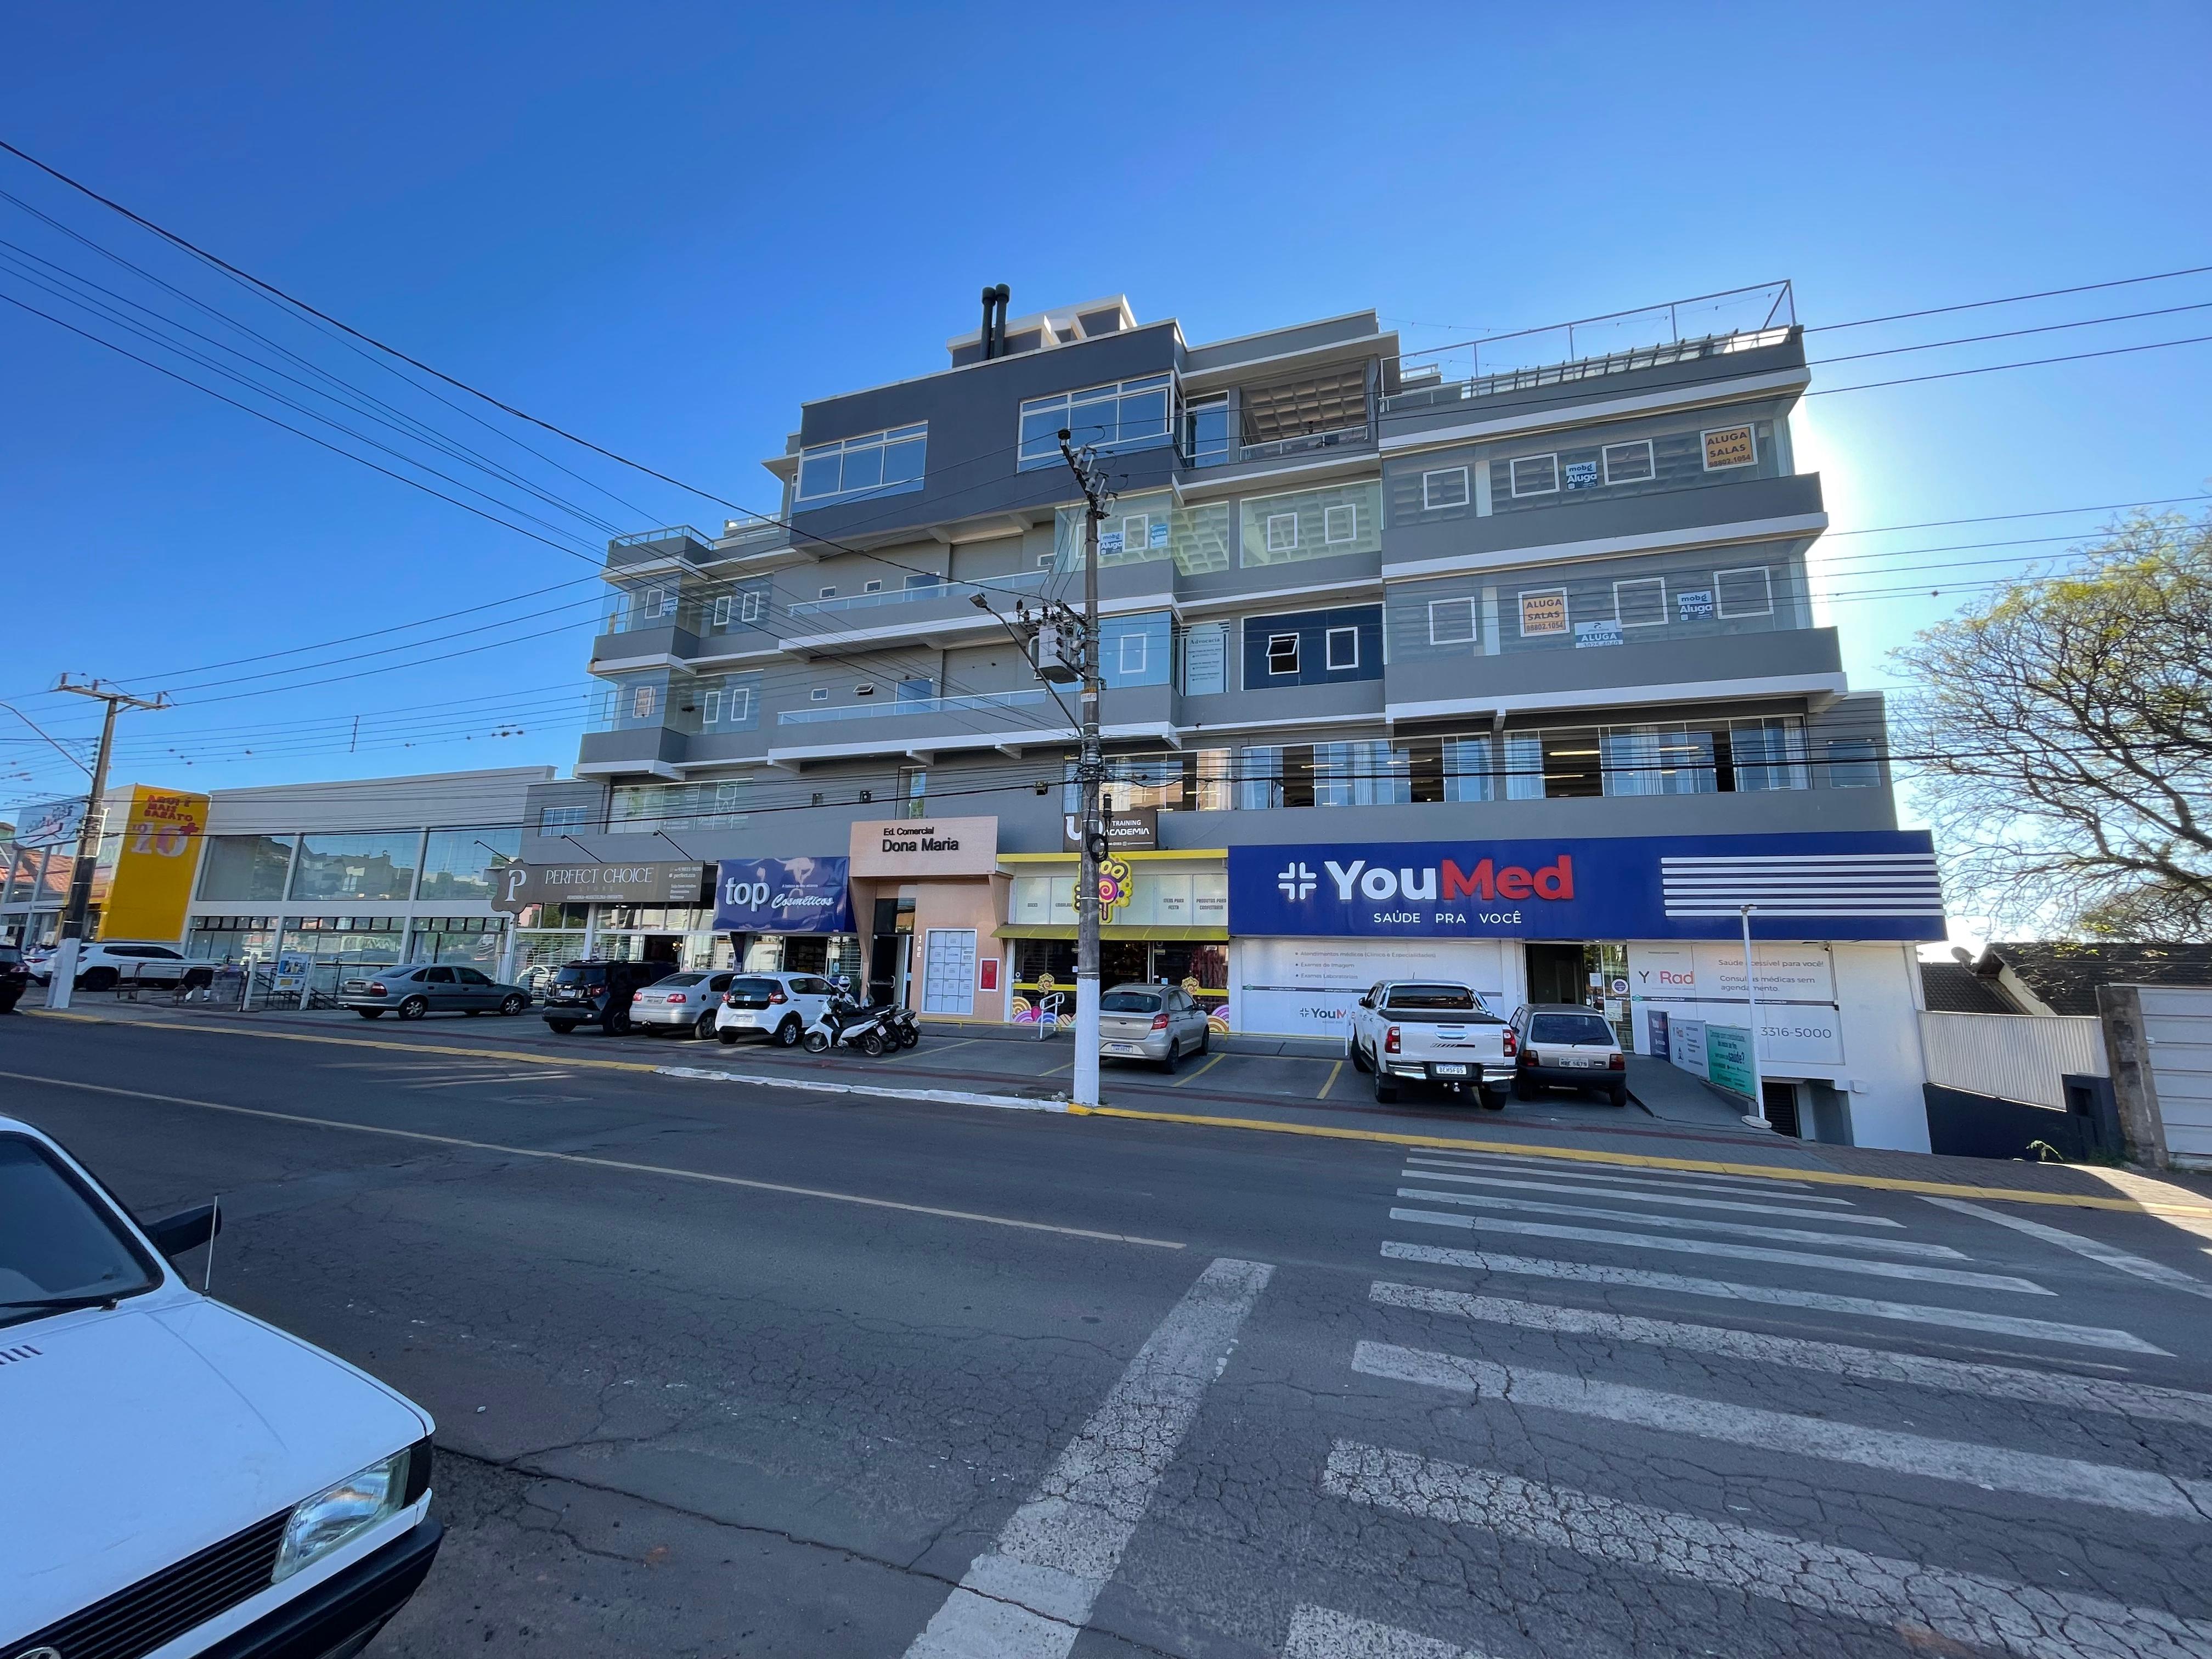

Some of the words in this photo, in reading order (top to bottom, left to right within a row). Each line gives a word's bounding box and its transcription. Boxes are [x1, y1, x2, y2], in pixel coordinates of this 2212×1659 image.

[1707, 432, 1747, 445] ALUGA
[1709, 444, 1746, 458] SALAS
[1567, 473, 1598, 483] Aluga
[1526, 599, 1562, 609] ALUGA
[1680, 605, 1713, 614] Aluga
[1528, 611, 1560, 621] SALAS
[1526, 622, 1564, 632] 98802.1054
[1581, 633, 1617, 642] ALUGA
[144, 809, 193, 822] BARATO
[897, 827, 934, 835] Comercial
[882, 839, 917, 852] Dona
[921, 837, 959, 851] Maria
[544, 868, 599, 885] PERFECT
[603, 867, 654, 883] CHOICE
[1324, 855, 1574, 901] YouMed
[725, 877, 770, 912] top
[771, 893, 834, 909] Cosméticos
[1374, 910, 1421, 923] SAÚDE
[1435, 913, 1466, 923] PRA
[1479, 911, 1522, 924] VOCÊ
[1660, 970, 1695, 984] Rad
[1760, 1026, 1832, 1038] 3316-5000
